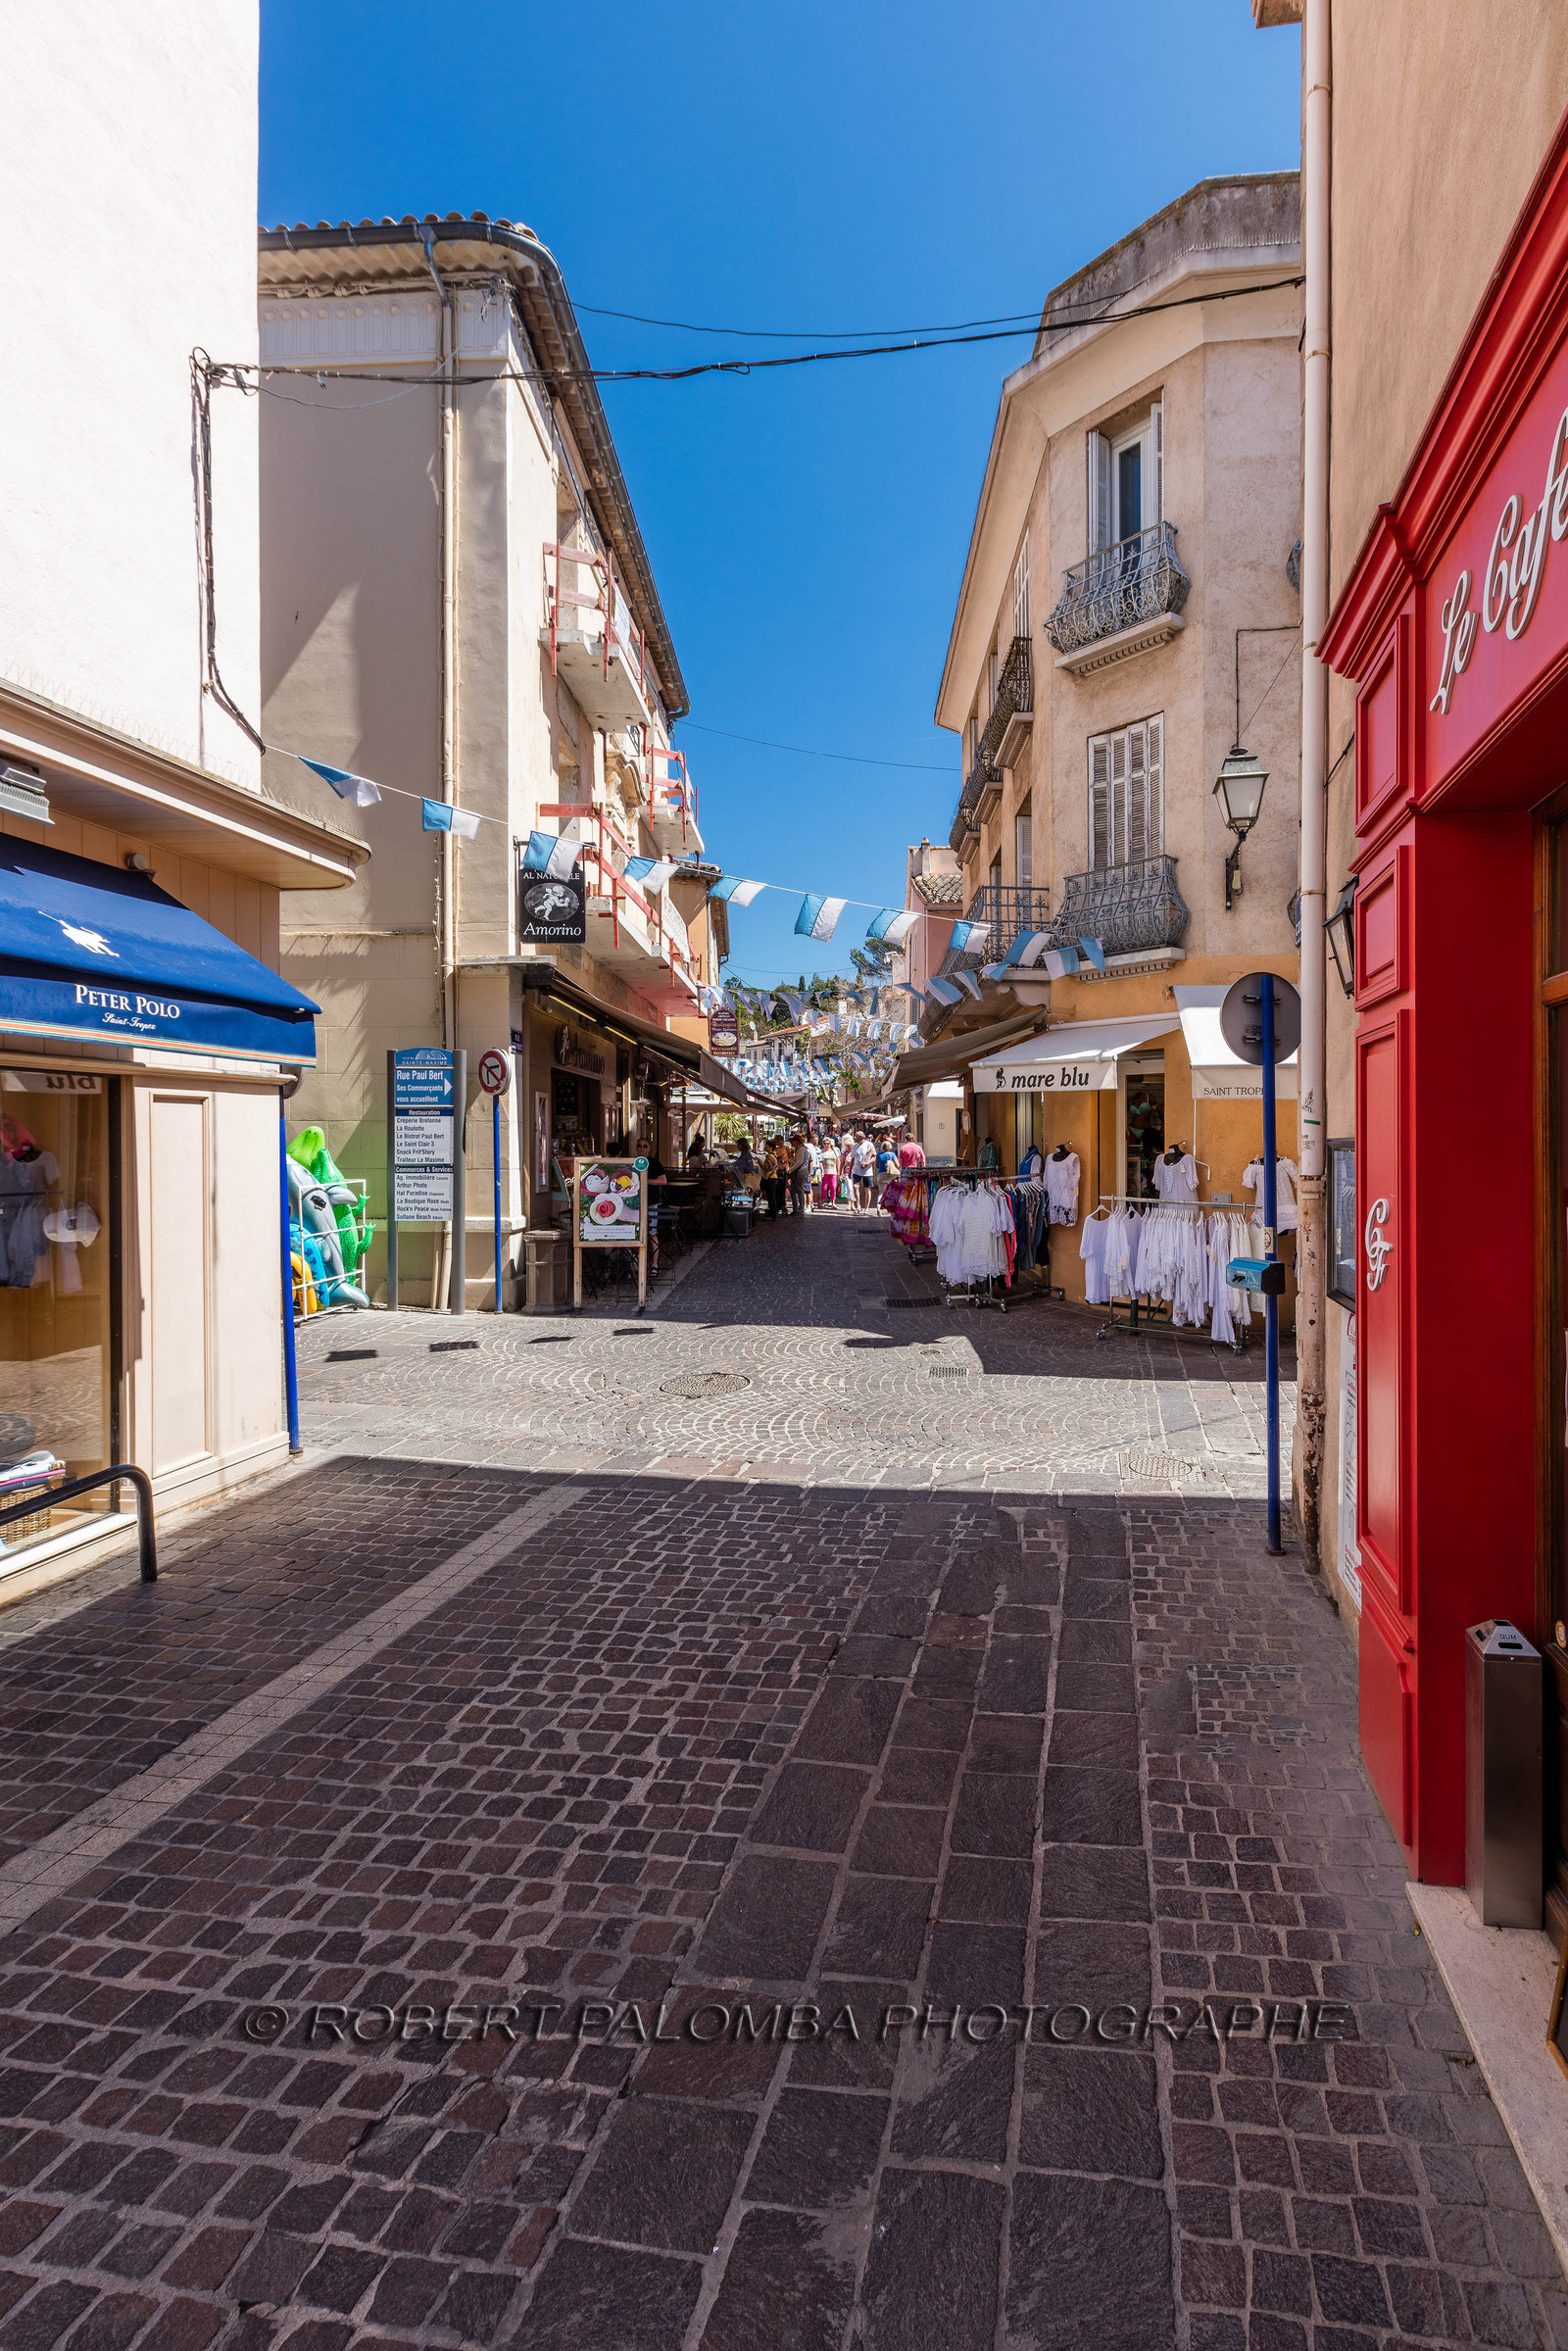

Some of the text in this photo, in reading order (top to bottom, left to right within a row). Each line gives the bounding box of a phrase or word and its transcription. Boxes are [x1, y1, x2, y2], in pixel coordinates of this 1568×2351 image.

[1430, 570, 1478, 715] Le
[523, 922, 582, 936] Amorino
[74, 983, 180, 1019] PETER POLO
[102, 1012, 157, 1032] Saint-Tropez
[397, 1070, 443, 1080] Rue Paul Bert
[1011, 1066, 1090, 1088] mare blu
[408, 1084, 443, 1093] Commerçants
[1203, 1087, 1232, 1096] SAINT
